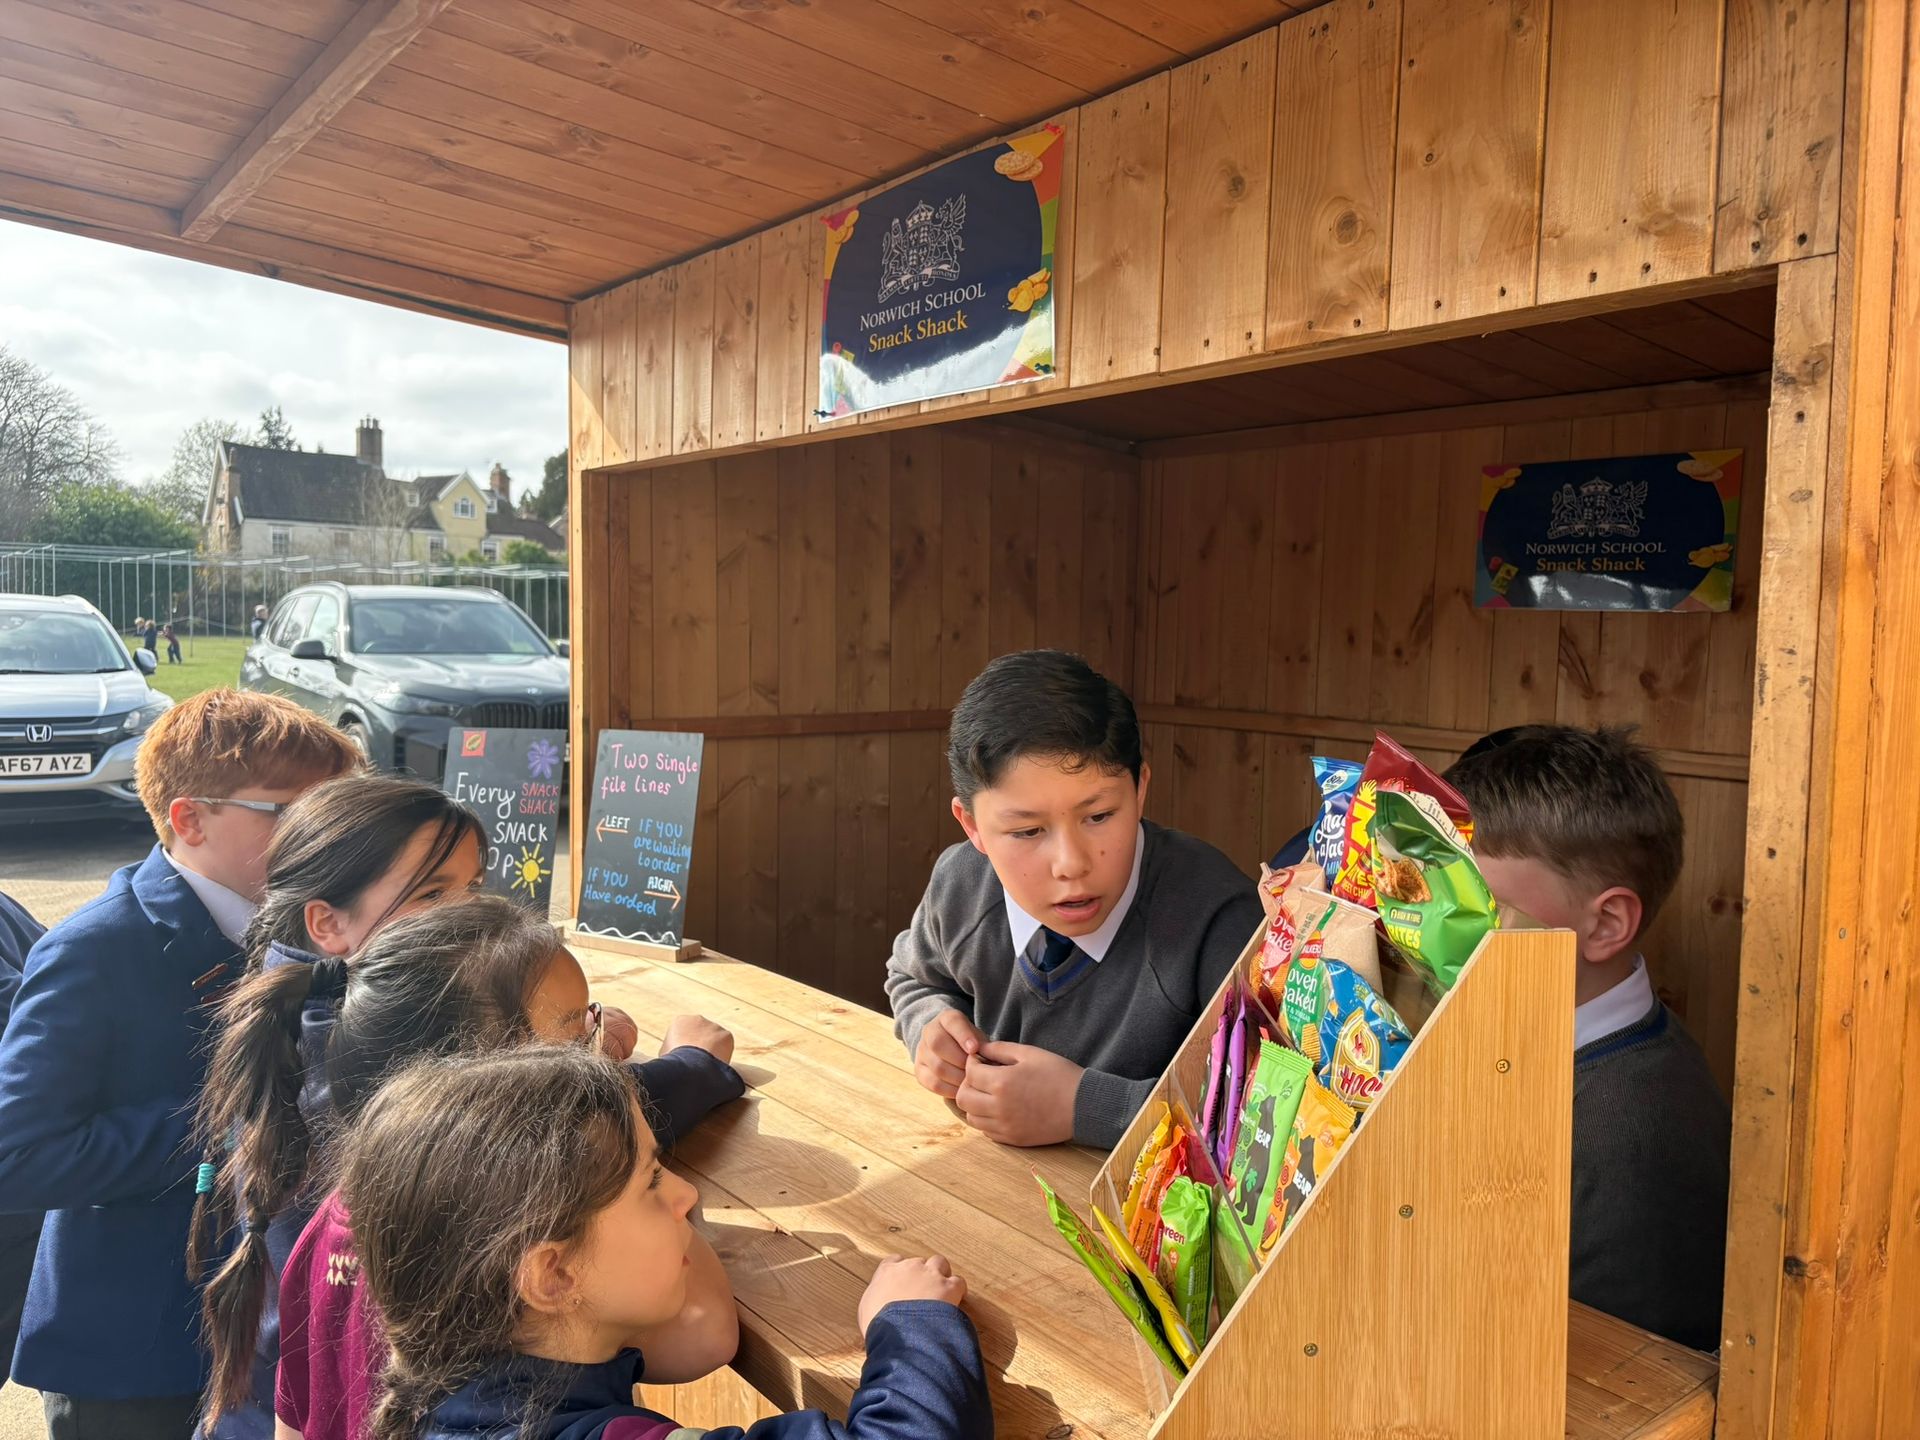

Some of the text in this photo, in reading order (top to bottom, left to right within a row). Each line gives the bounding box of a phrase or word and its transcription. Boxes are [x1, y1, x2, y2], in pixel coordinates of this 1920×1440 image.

[860, 300, 920, 331] NORWICH
[925, 283, 986, 311] SCHOOL
[869, 310, 968, 352] Snack Shack
[1526, 541, 1666, 555] NORWICH SCHOOL
[1536, 557, 1646, 572] Snack Shack
[0, 756, 83, 772] AF67 AYZ
[611, 744, 648, 769] Two
[456, 772, 516, 819] Every
[522, 783, 559, 797] SNACK
[601, 775, 671, 800] file lines
[520, 799, 555, 814] SHACK
[605, 815, 630, 829] LEFT
[493, 822, 548, 844] SNACK
[634, 837, 652, 850] are
[639, 852, 681, 873] to order
[584, 884, 611, 903] Have
[1269, 930, 1293, 951] ake
[1288, 968, 1317, 993] oven
[1163, 1224, 1185, 1246] reen
